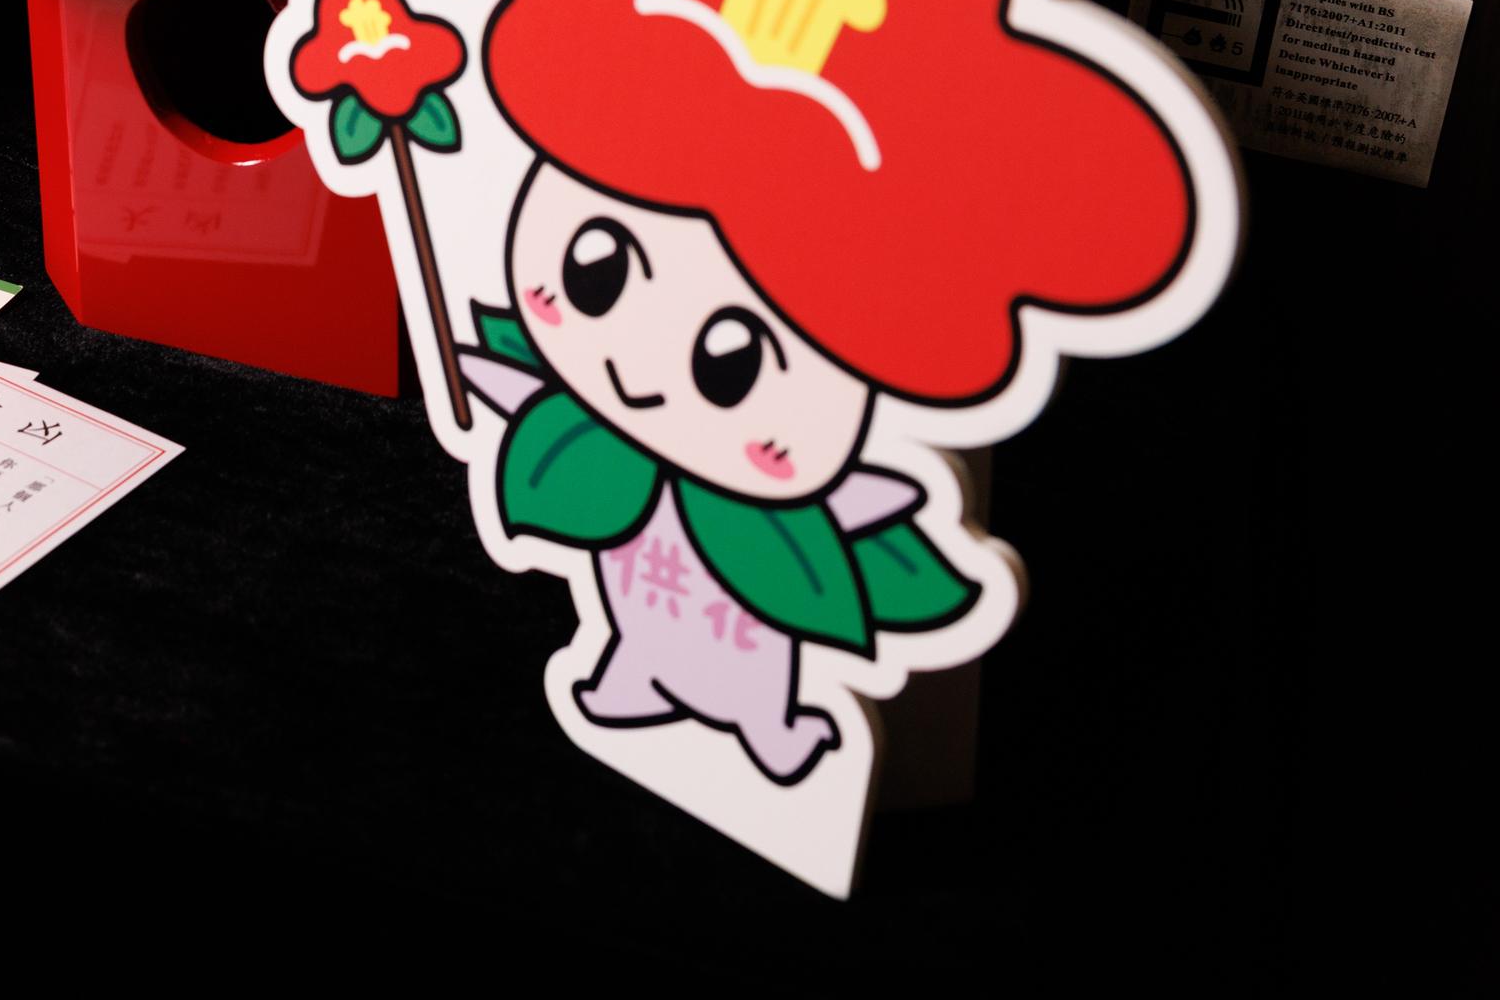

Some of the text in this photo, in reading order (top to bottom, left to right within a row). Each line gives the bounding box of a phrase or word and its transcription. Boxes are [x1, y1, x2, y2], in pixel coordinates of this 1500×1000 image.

[1350, 0, 1376, 14] with
[1377, 6, 1396, 18] BS
[1281, 33, 1396, 66] for medium hazard
[1285, 17, 1437, 60] Direct test/predictive test
[1274, 64, 1358, 91] inappropriate
[1278, 49, 1396, 83] Delete Whichever is
